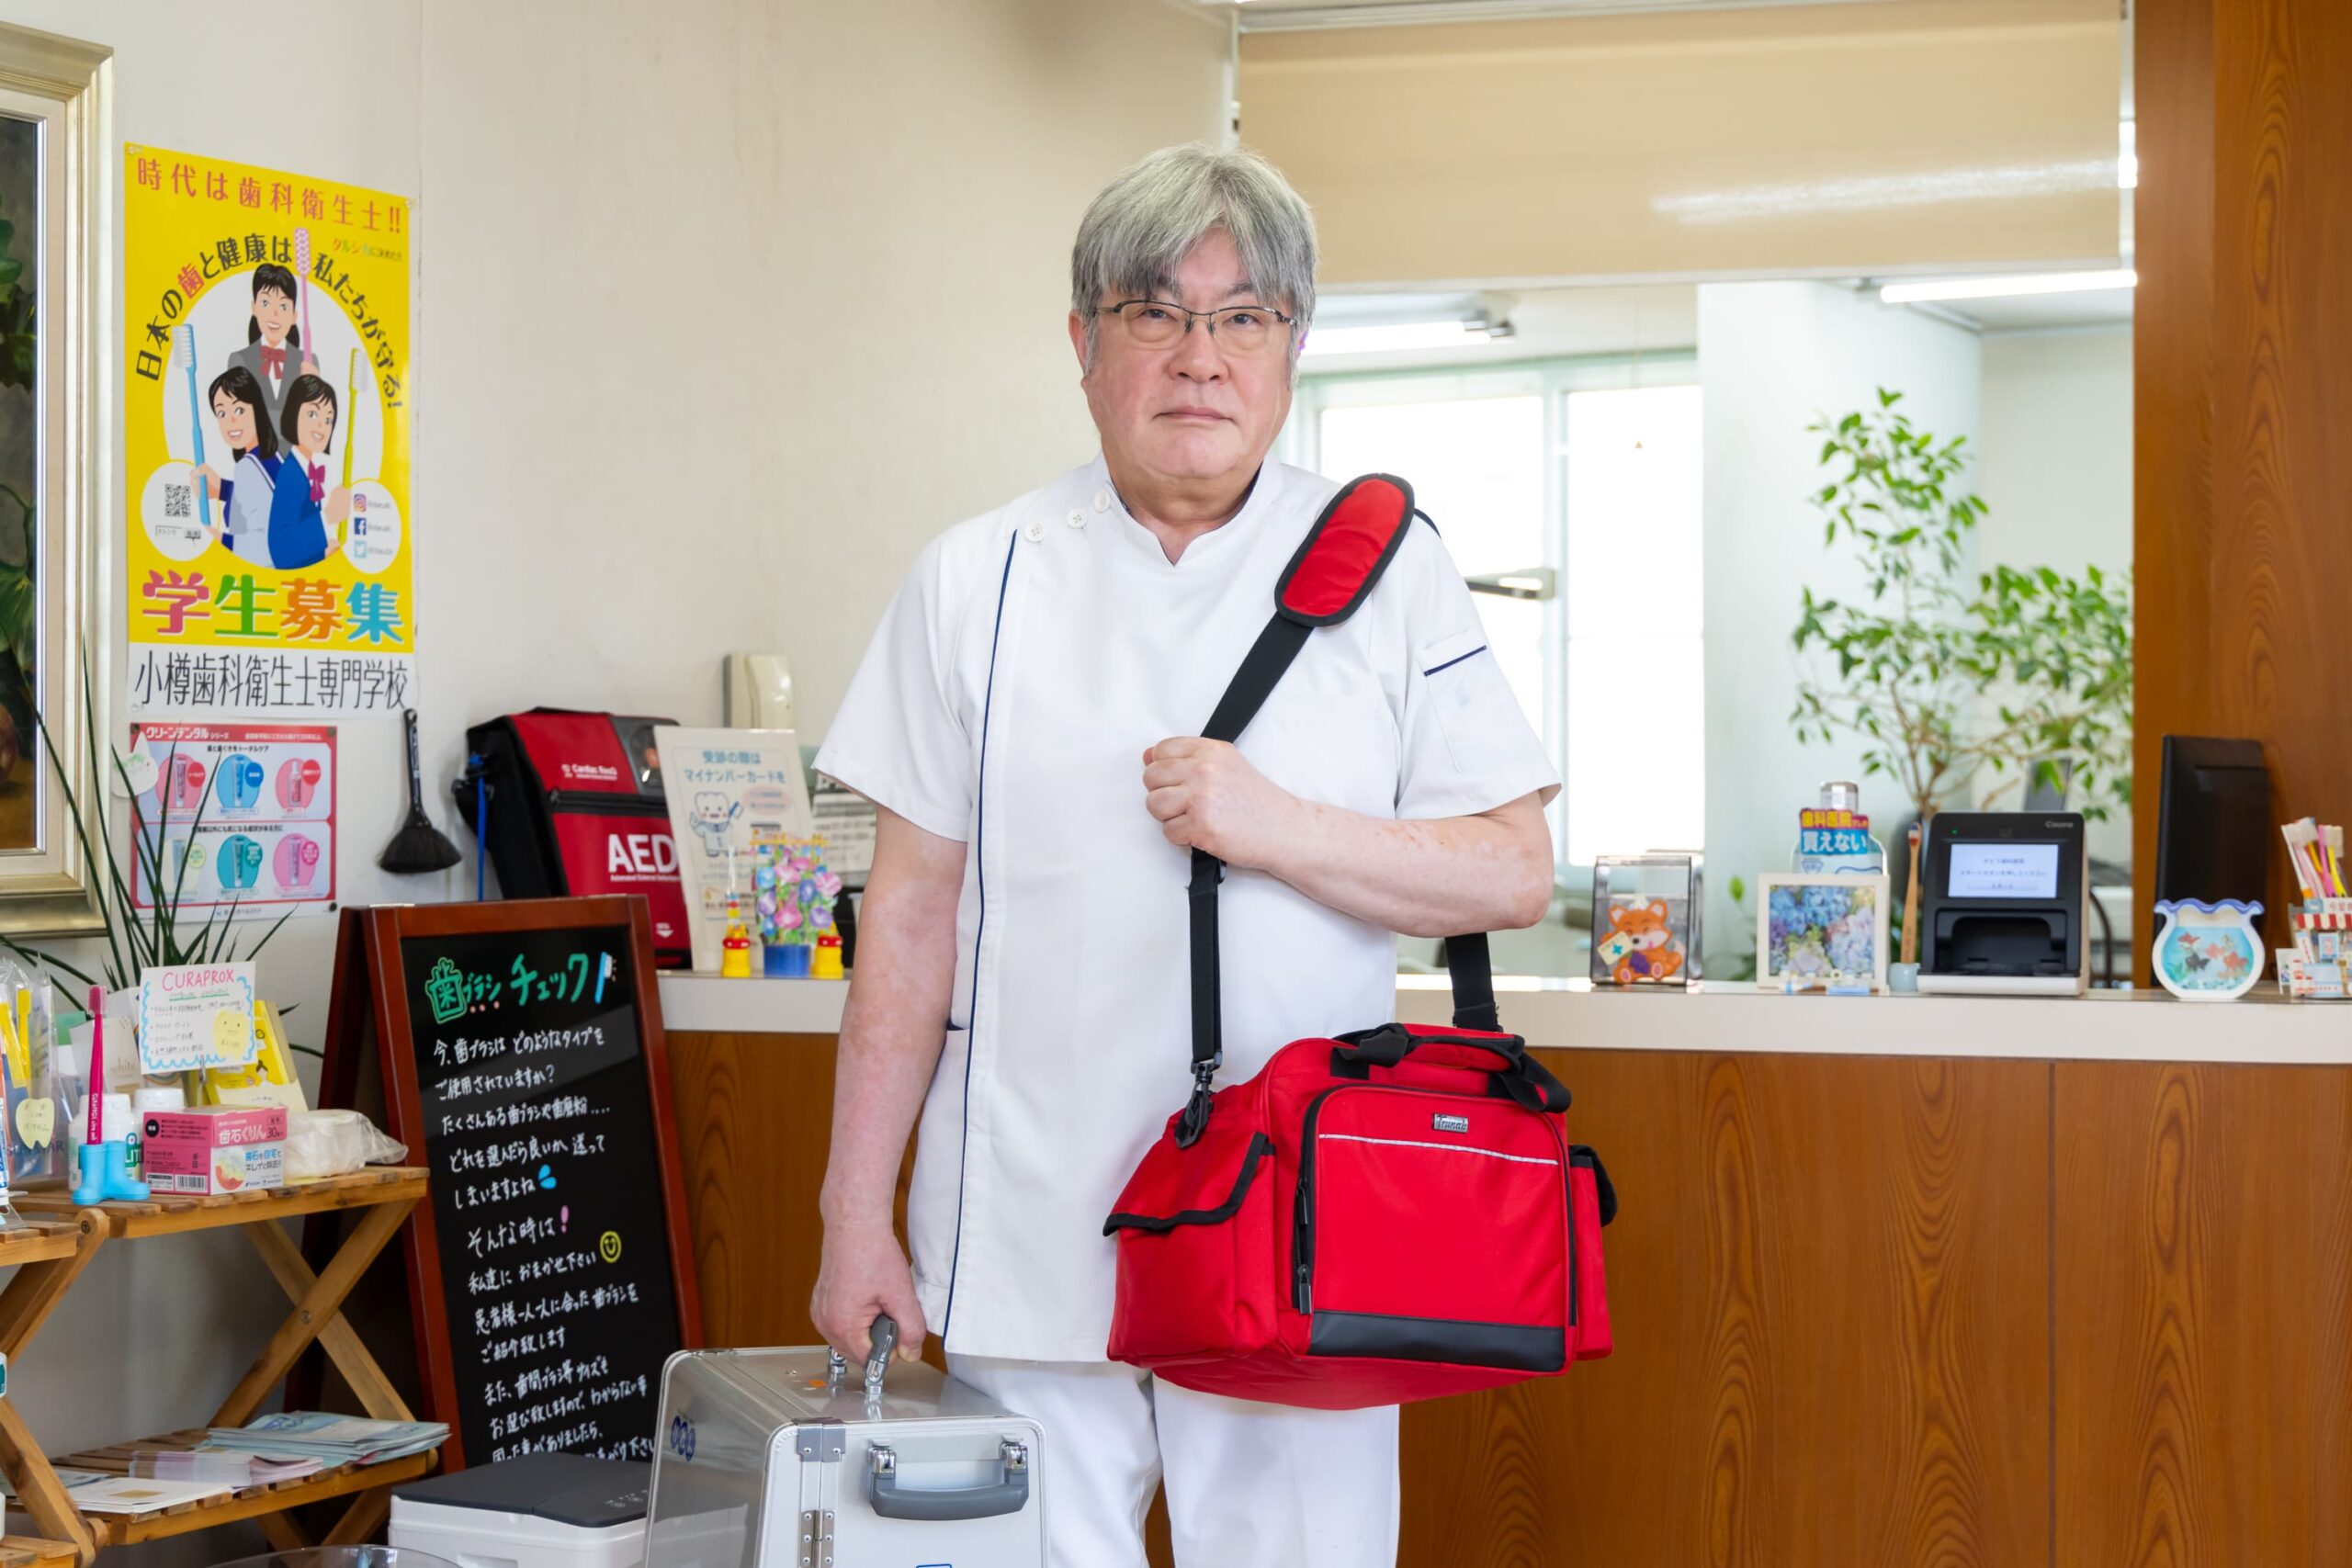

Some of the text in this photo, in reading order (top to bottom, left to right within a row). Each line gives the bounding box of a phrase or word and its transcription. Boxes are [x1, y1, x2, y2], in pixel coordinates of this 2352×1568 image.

[136, 232, 291, 381] 日本の歯と健康は
[141, 570, 404, 644] 学生募集
[135, 650, 409, 710] 小樽歯科衛生士専門学校
[684, 768, 786, 784] マイナンバーカードを
[608, 833, 679, 874] AED
[1803, 830, 1867, 852] 買えない
[162, 969, 234, 991] CURAPROX
[219, 1124, 266, 1145] 歯石くりん
[455, 1177, 537, 1210] しまいますよね
